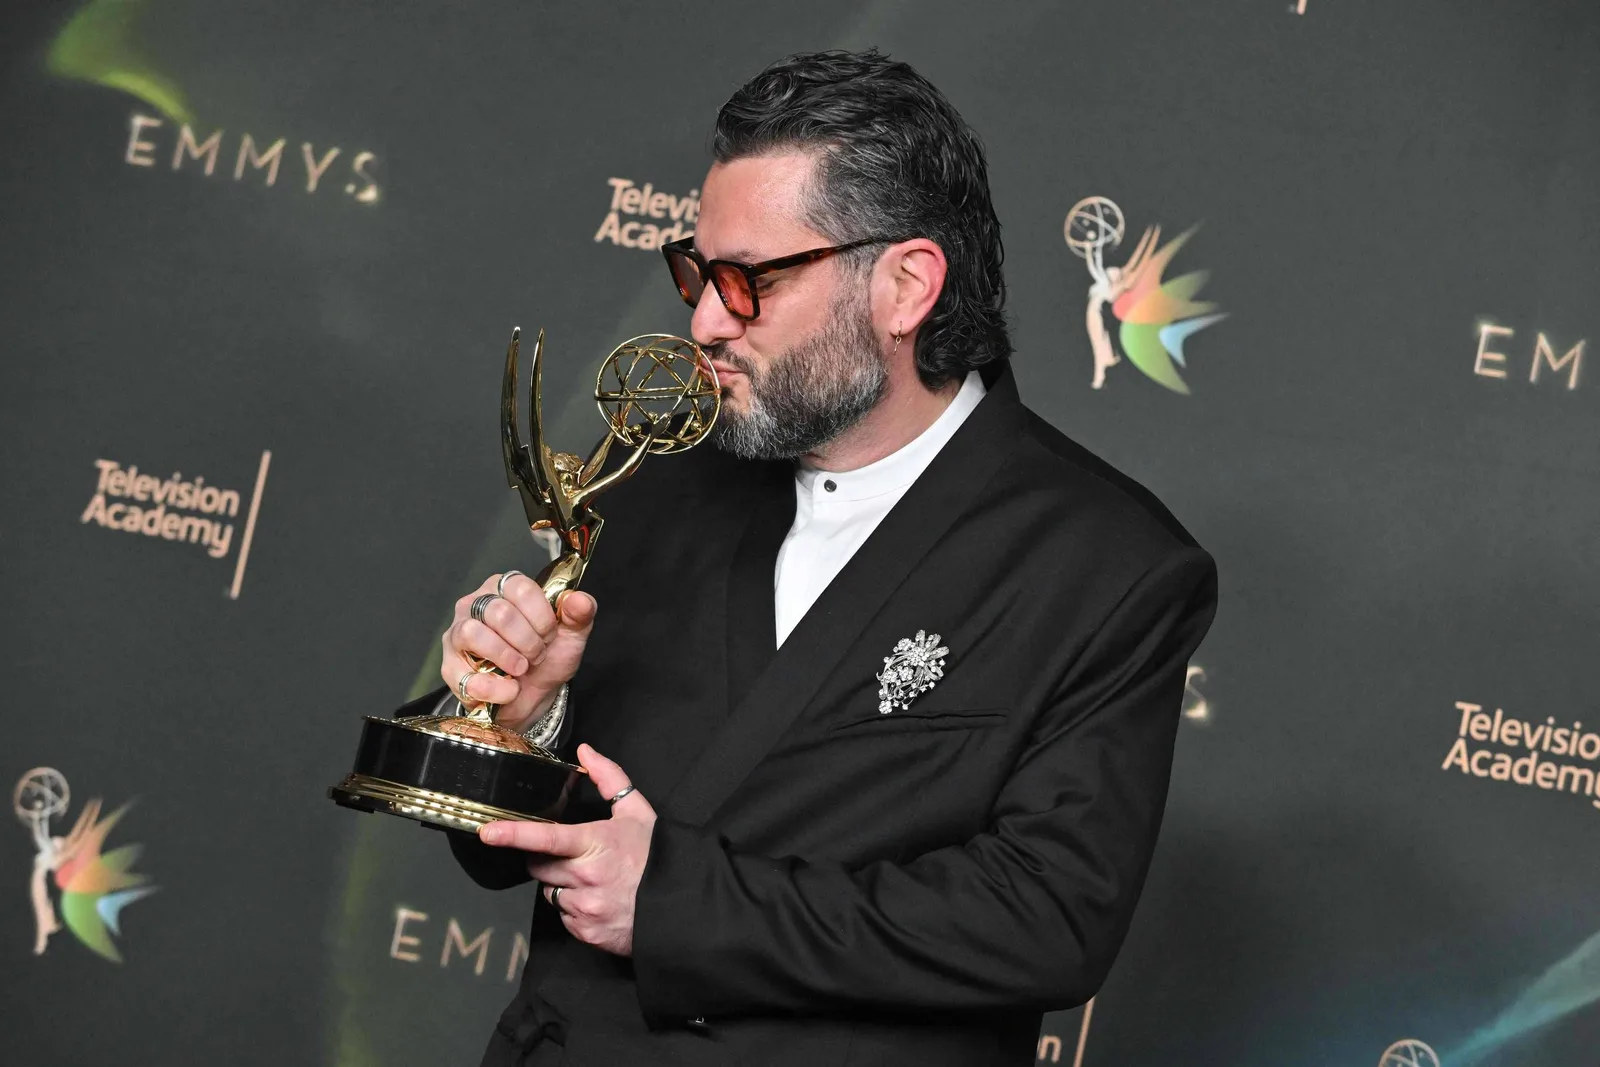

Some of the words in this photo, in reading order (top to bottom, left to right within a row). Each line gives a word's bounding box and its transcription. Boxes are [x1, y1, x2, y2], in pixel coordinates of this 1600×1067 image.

[124, 113, 379, 203] EMMYS
[607, 177, 700, 223] Televi
[1474, 323, 1586, 390] EM
[95, 458, 240, 517] Television
[80, 493, 234, 558] Academy
[1455, 701, 1600, 760] Televisio
[1037, 1035, 1062, 1063] n
